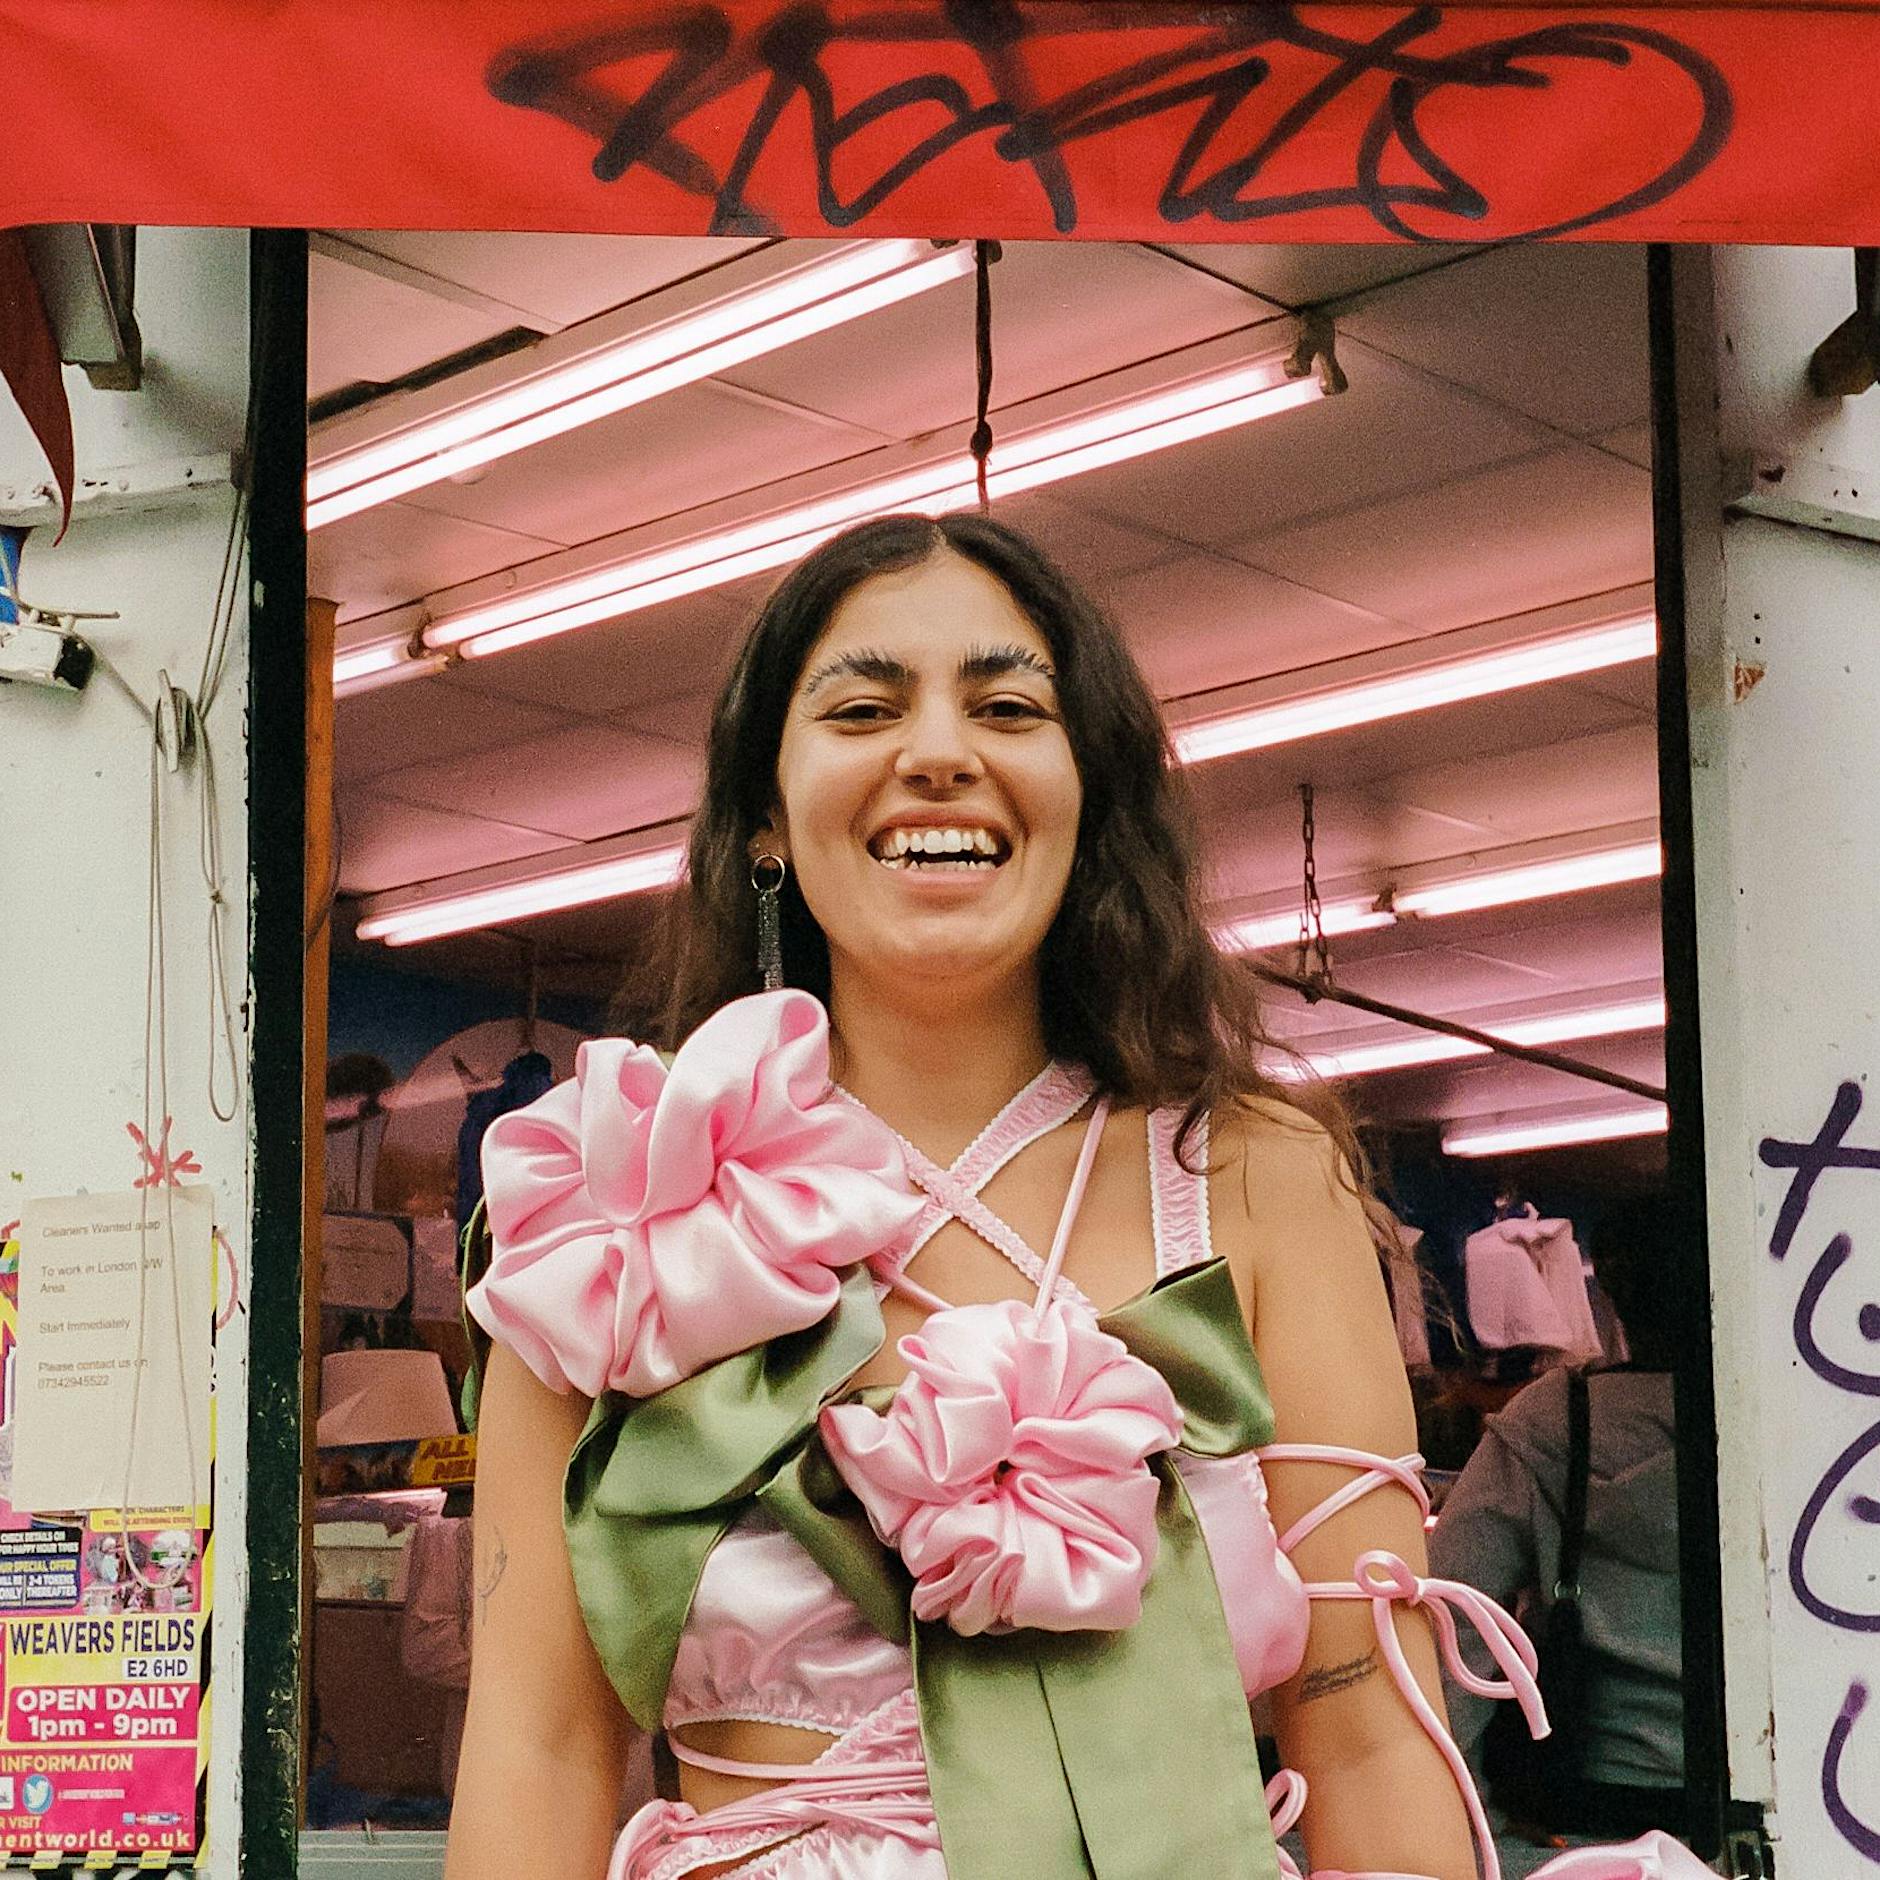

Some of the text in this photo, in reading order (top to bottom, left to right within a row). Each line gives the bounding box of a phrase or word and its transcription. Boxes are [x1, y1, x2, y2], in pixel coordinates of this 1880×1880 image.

[42, 1226, 89, 1238] Cleaners
[91, 1222, 132, 1233] Wanted
[41, 1265, 55, 1277] To
[58, 1265, 81, 1276] work
[85, 1264, 95, 1274] in
[98, 1260, 137, 1274] London
[40, 1282, 65, 1294] Area
[40, 1319, 131, 1334] Start Immediately
[38, 1361, 74, 1372] Please
[76, 1359, 115, 1370] contact
[118, 1359, 131, 1368] us
[422, 1440, 469, 1459] ALL
[10, 1618, 195, 1655] WEAVERS FIELDS
[127, 1659, 188, 1677] E2 6HD
[16, 1687, 190, 1712] OPEN DAILY
[27, 1715, 87, 1740] 1pm
[113, 1713, 178, 1739] 9pm
[1, 1753, 134, 1773] INFORMATION
[8, 1815, 43, 1830] VISIT
